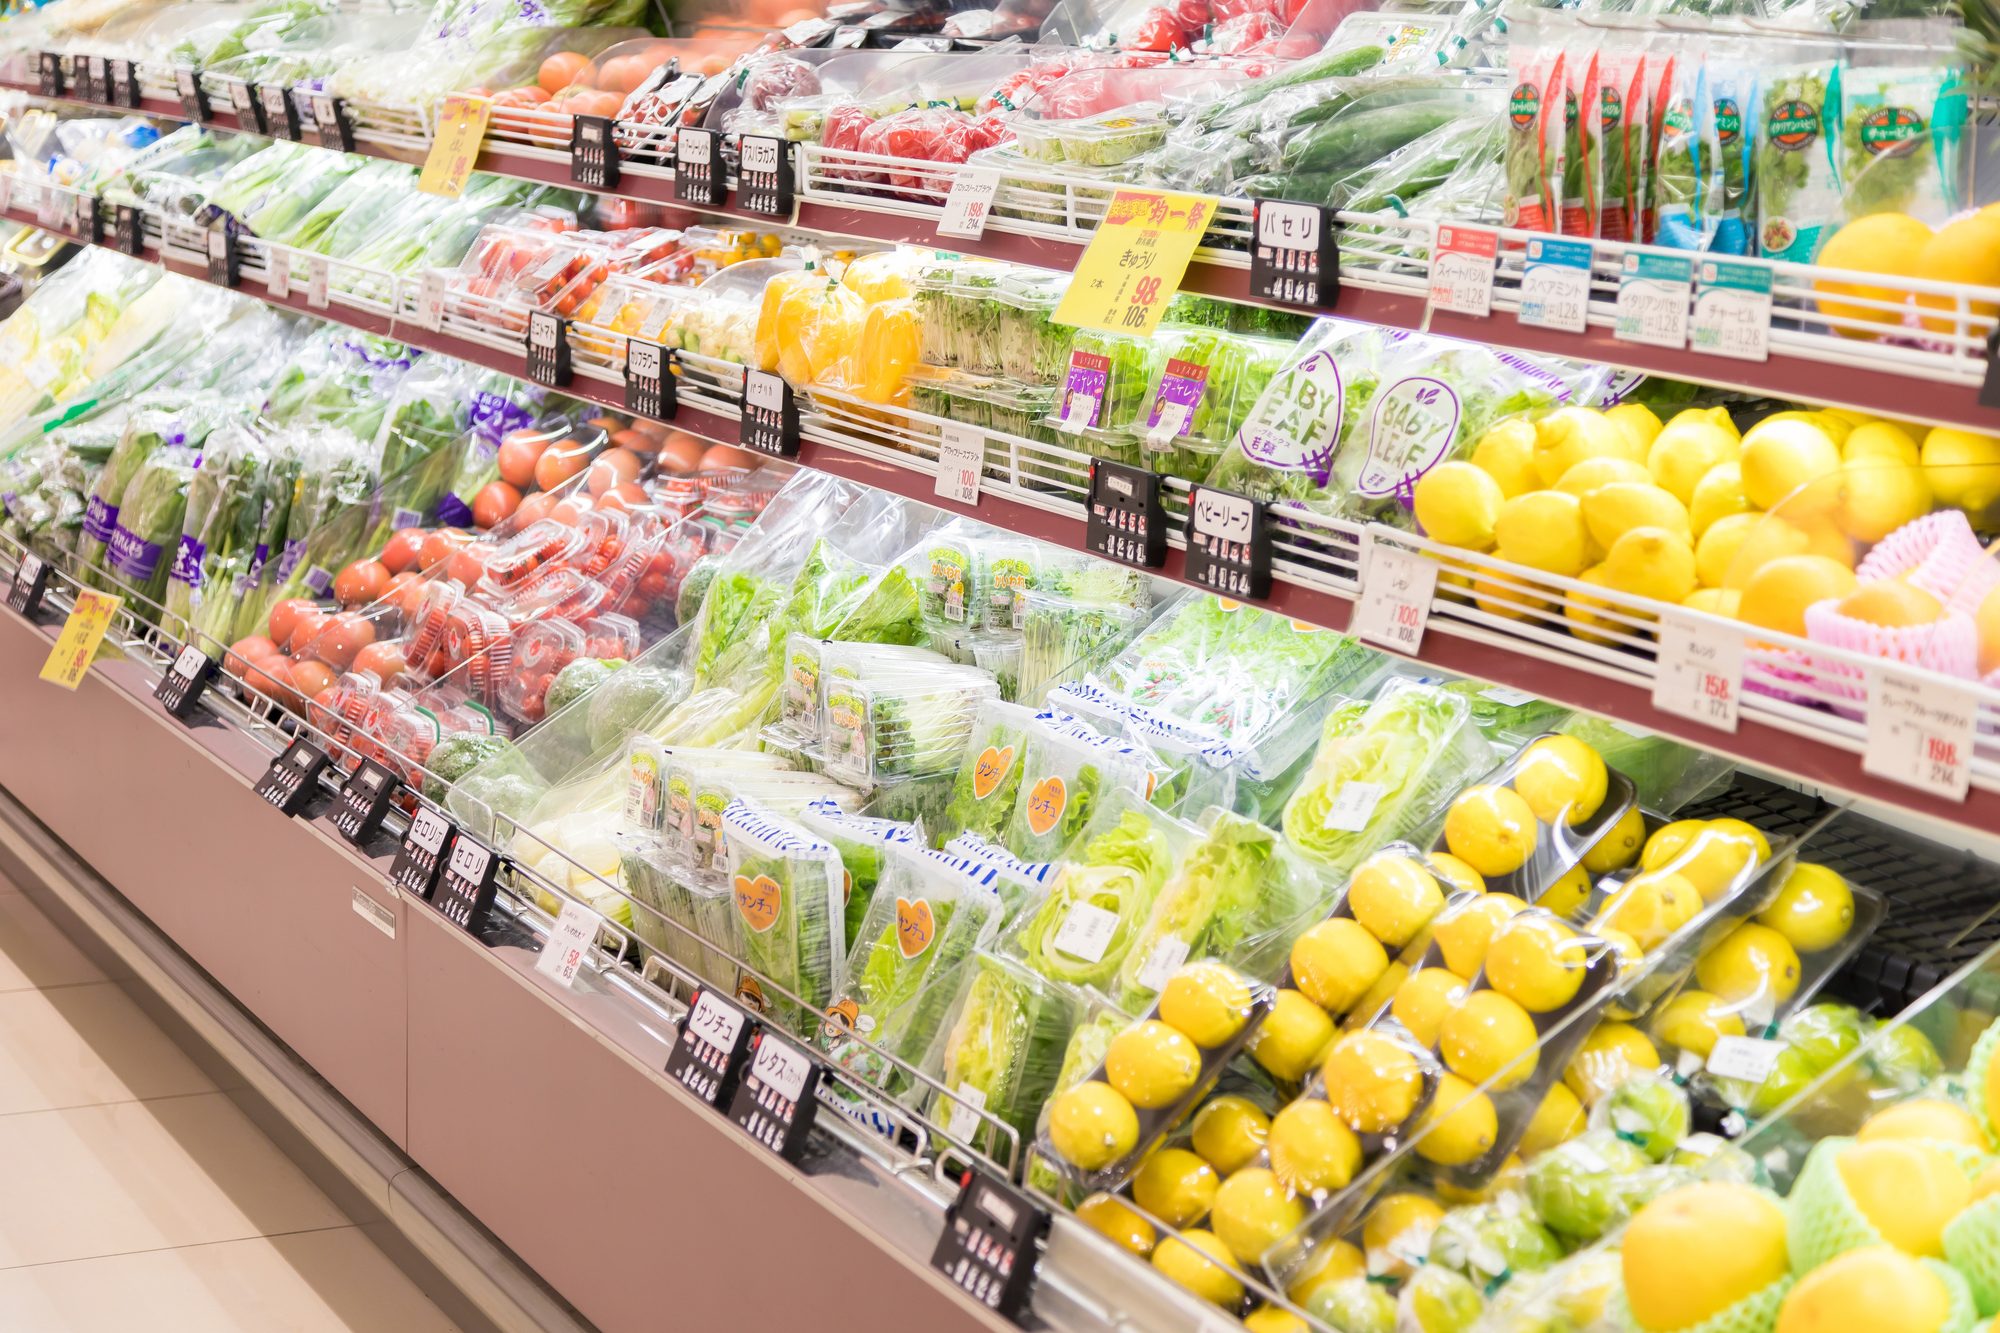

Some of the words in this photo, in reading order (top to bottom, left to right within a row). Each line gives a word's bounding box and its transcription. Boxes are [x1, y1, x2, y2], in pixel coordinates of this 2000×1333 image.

[743, 145, 777, 164] アスパラガス
[967, 202, 984, 218] 198
[1149, 199, 1207, 231] 均一祭
[965, 219, 980, 230] 214
[1264, 212, 1312, 239] パセリ
[1118, 249, 1158, 270] きゅうり
[1089, 279, 1105, 289] 2本
[1529, 278, 1582, 297] スペアミント
[1465, 287, 1484, 305] 128
[1622, 293, 1683, 314] イタリアンパセリ
[1558, 302, 1578, 320] 128
[1709, 304, 1757, 324] チャービル
[531, 319, 555, 342] ミニトマト
[1656, 315, 1679, 332] 128
[1737, 327, 1761, 345] 128
[630, 348, 658, 369] カリフラワー
[1272, 371, 1336, 418] ABY
[1257, 399, 1328, 446] EAF
[1382, 396, 1449, 444] BABY
[1251, 436, 1276, 456] 若葉
[1374, 426, 1427, 474] LEAF
[961, 469, 975, 487] 100
[962, 487, 974, 500] 108
[1197, 500, 1250, 532] ベビーリーフ
[931, 563, 962, 582] かいわれ
[994, 575, 1026, 589] かいわれ
[1392, 579, 1410, 591] レモン
[1397, 605, 1419, 627] 100
[1398, 626, 1414, 643] 108
[1688, 642, 1716, 659] オレンジ
[1705, 672, 1729, 700] 158
[1928, 736, 1958, 766] 198
[1029, 795, 1056, 818] サンチュ
[454, 845, 484, 875] セロリ
[739, 891, 773, 915] サンチュ
[566, 949, 580, 967] 58
[562, 966, 573, 979] 63
[695, 1002, 735, 1043] サンチュ
